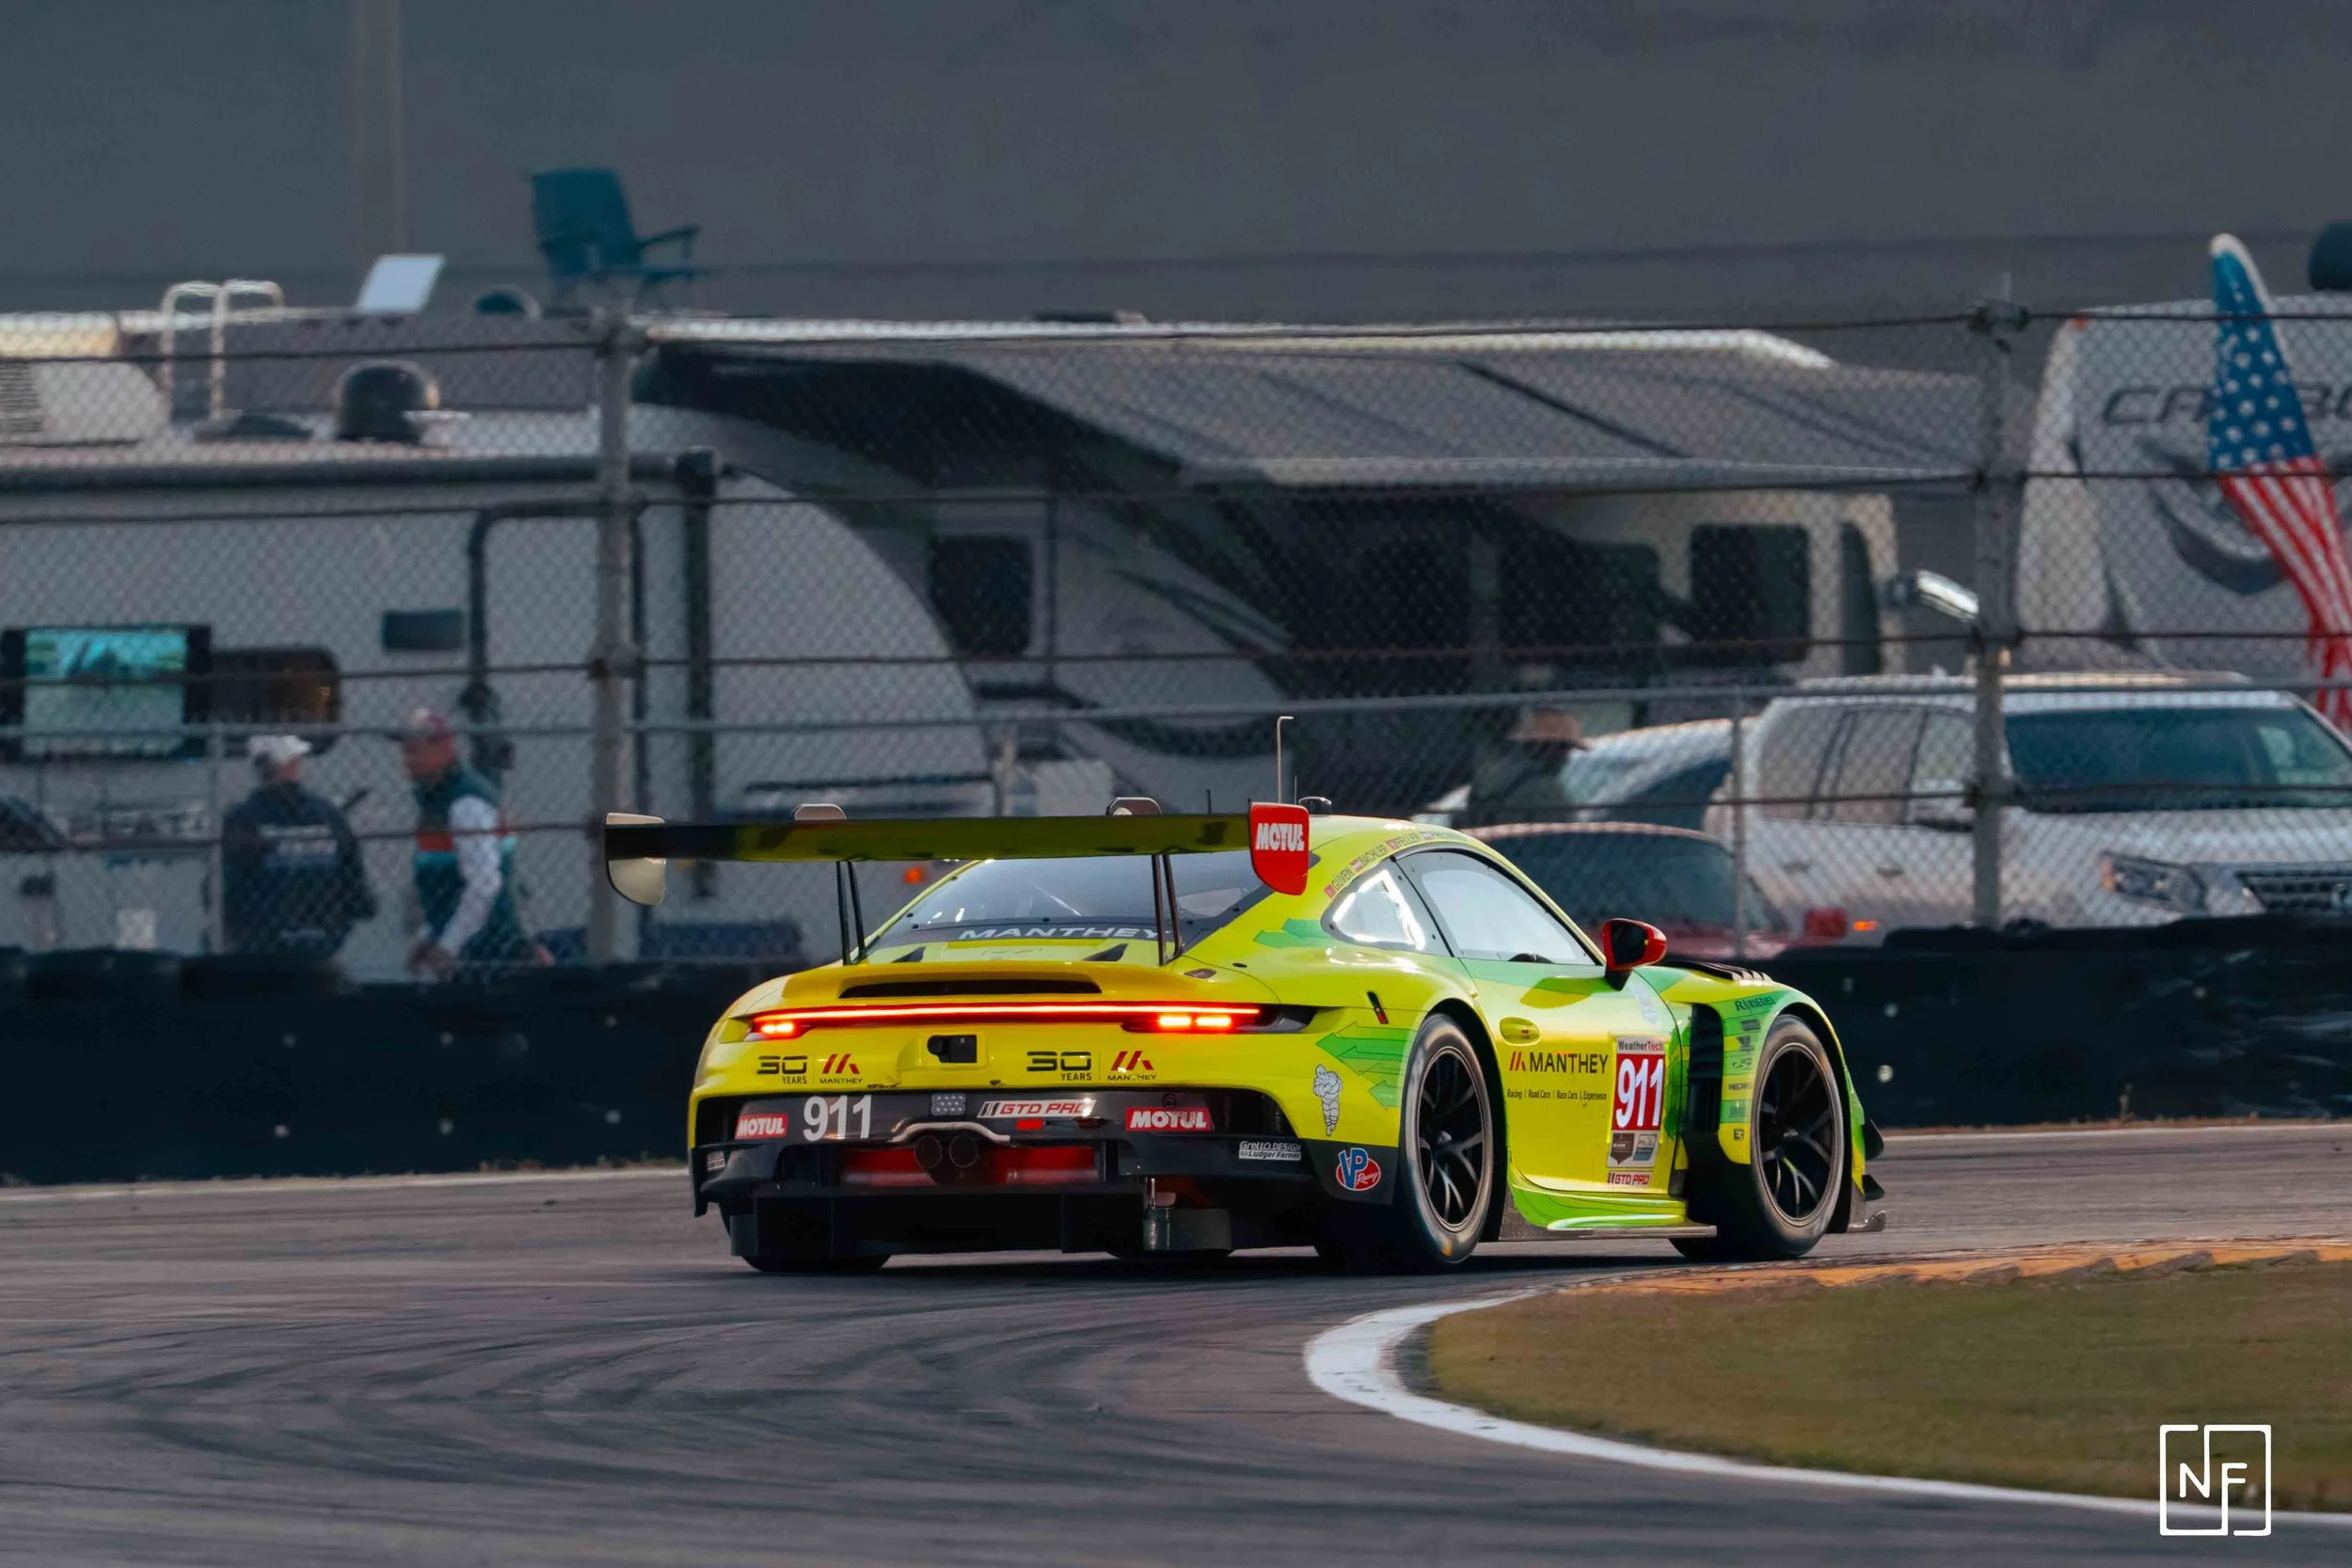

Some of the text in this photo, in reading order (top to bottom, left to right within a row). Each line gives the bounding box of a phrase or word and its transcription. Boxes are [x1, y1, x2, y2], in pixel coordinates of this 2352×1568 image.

[1256, 822, 1305, 851] MOTUL
[959, 927, 1169, 940] MANTHEY
[1618, 1041, 1663, 1052] WeatherTech
[756, 1055, 808, 1074] 30
[1026, 1051, 1091, 1071] 30
[1529, 1052, 1608, 1074] MANTHEY
[782, 1076, 807, 1085] YEARS
[1060, 1072, 1092, 1081] YEARS
[1507, 1089, 1522, 1100] Racing
[1615, 1058, 1664, 1128] 911
[1000, 1104, 1042, 1115] GTD
[738, 1118, 785, 1135] MOTUL
[803, 1095, 872, 1142] 911
[1130, 1111, 1206, 1129] MOTUL
[1339, 1148, 1368, 1190] VP
[1615, 1175, 1631, 1184] GTD
